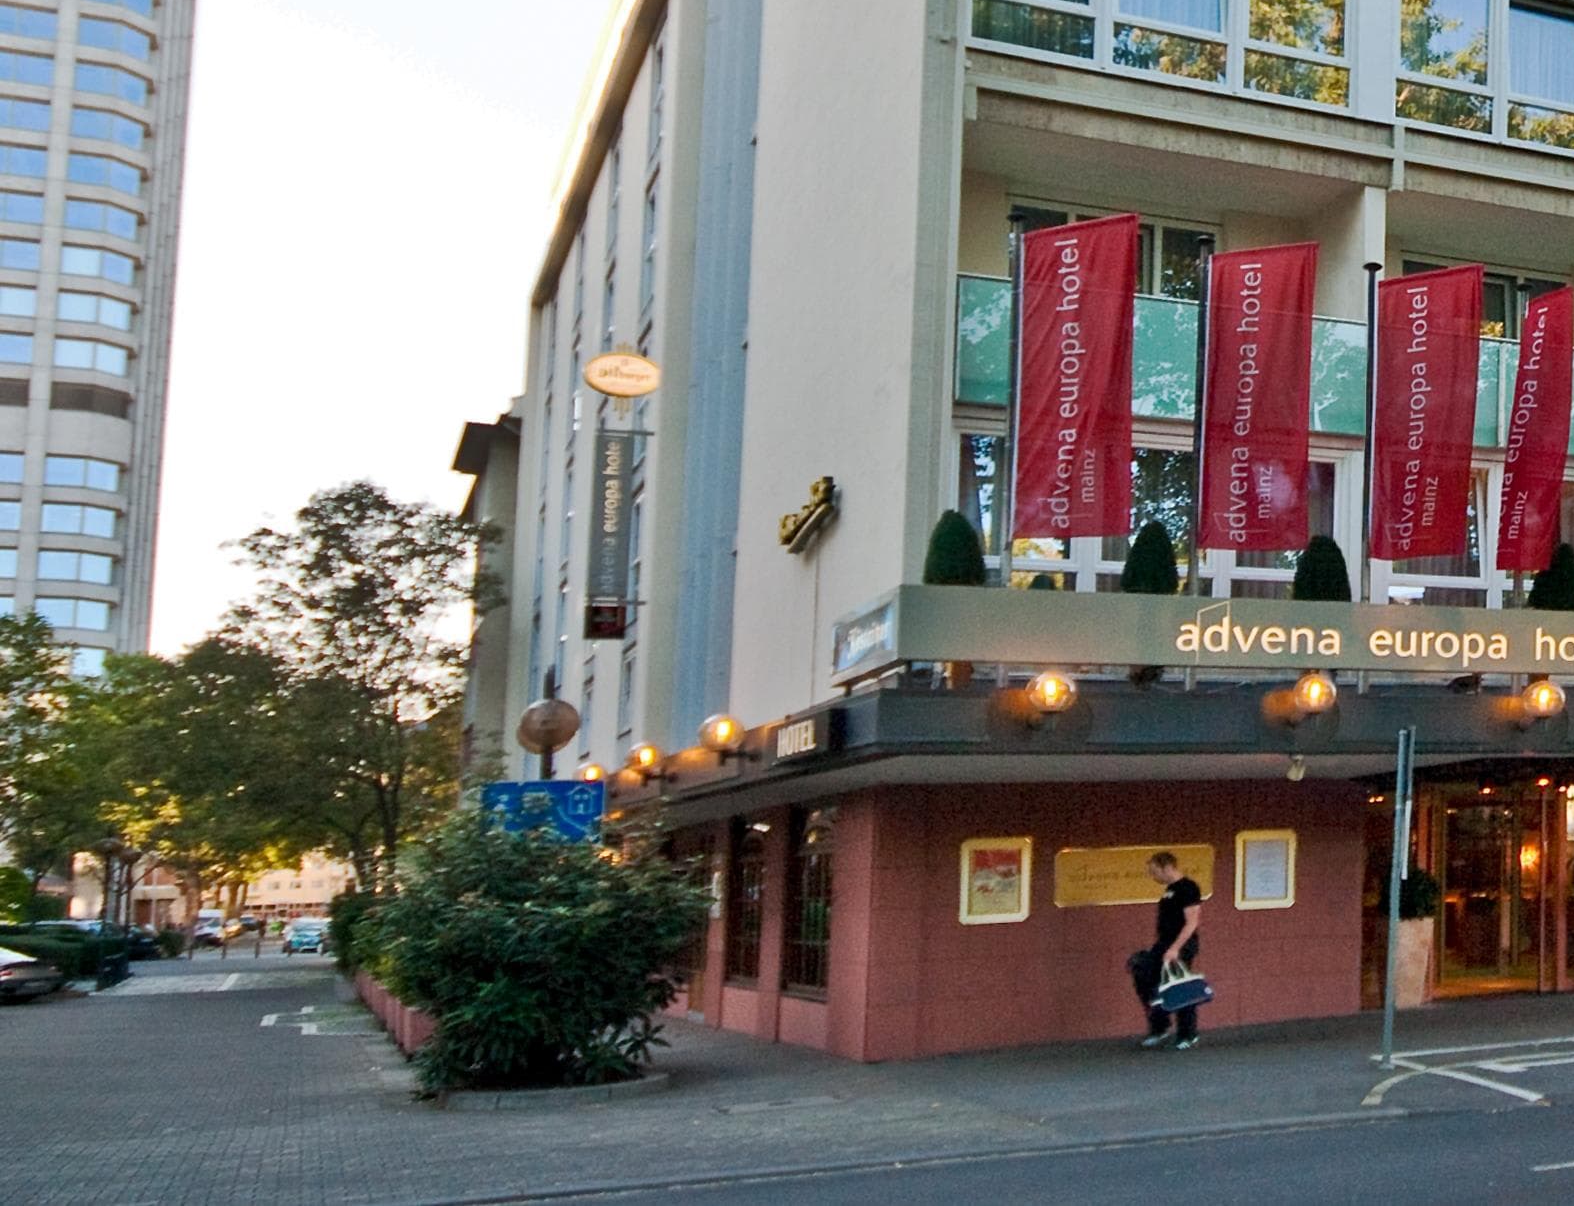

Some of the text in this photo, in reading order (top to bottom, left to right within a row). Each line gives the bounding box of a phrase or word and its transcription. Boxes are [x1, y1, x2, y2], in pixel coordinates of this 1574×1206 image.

[1049, 238, 1086, 529] advena europa hotel
[1223, 263, 1262, 543] advena europa hotel
[1395, 286, 1432, 551] advena europa hotel
[1507, 381, 1538, 463] europa
[1080, 448, 1097, 503] mainz
[1258, 466, 1273, 520] mainz
[1421, 477, 1439, 527] mainz
[603, 479, 622, 533] europa
[1508, 490, 1528, 540] mainz
[1176, 617, 1341, 656] advena
[1369, 627, 1508, 668] europa
[777, 720, 816, 759] HOTEL
